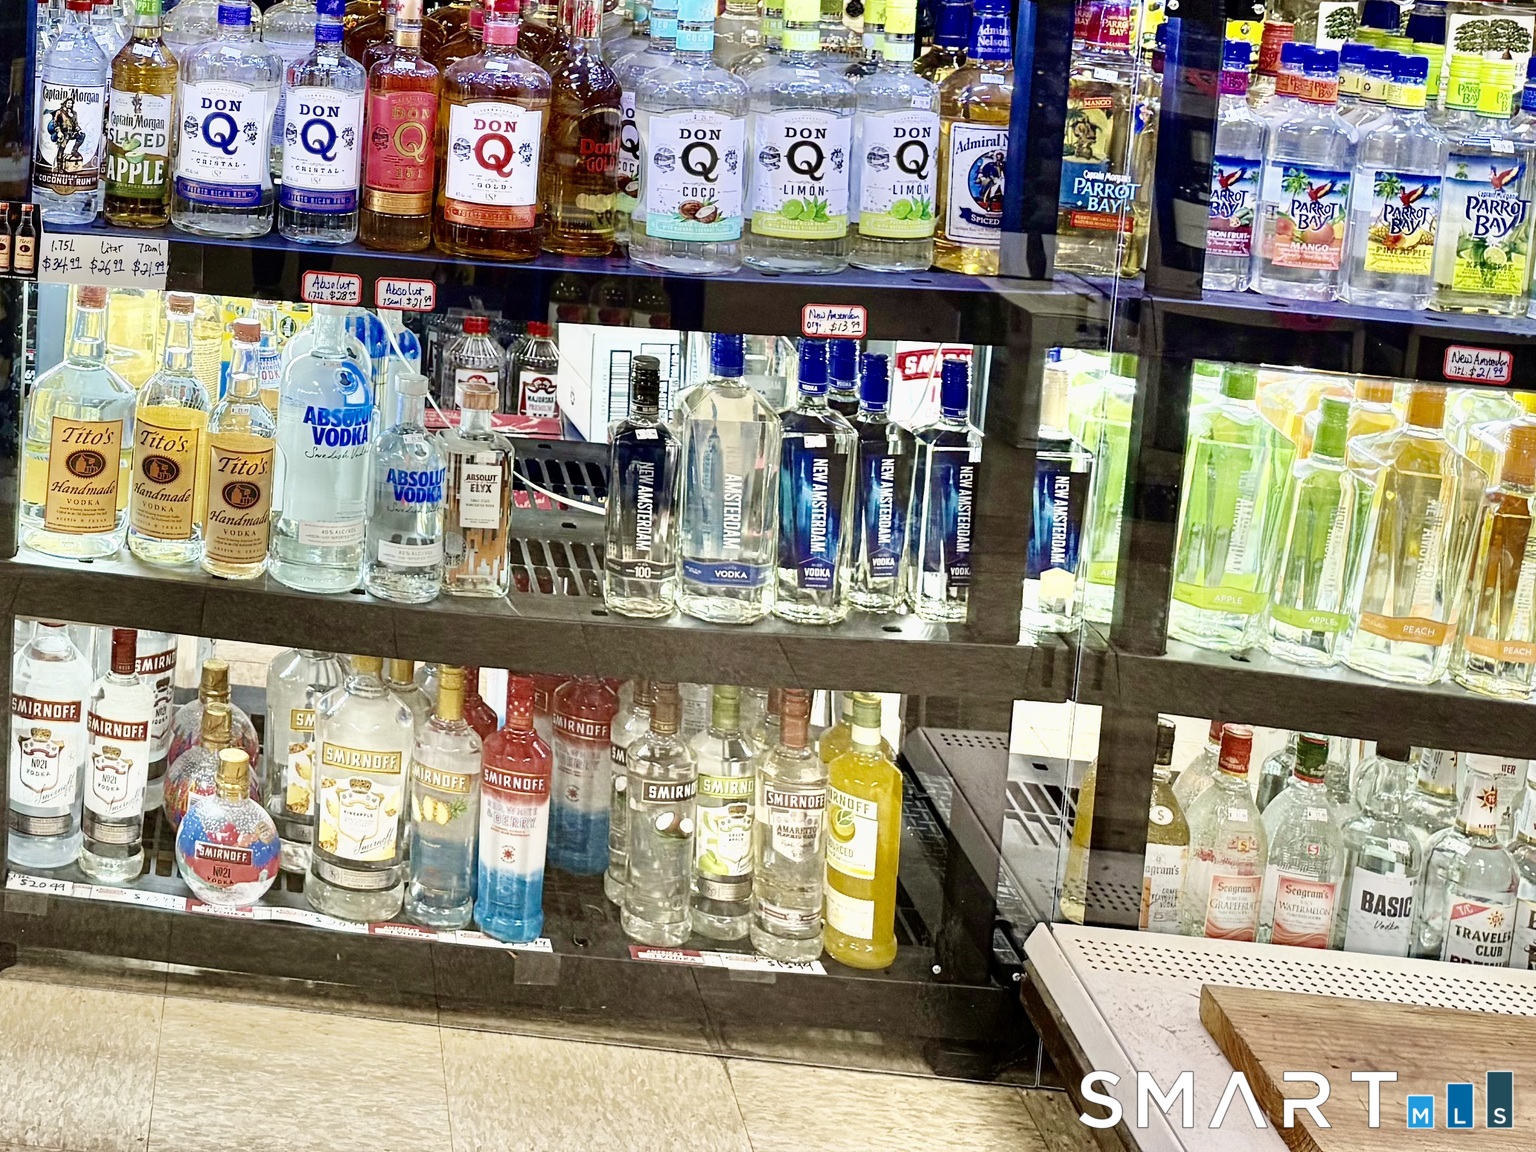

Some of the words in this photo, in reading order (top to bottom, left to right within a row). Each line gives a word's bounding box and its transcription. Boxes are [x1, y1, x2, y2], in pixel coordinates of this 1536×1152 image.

[202, 96, 241, 111] DON
[202, 111, 239, 157] Q
[473, 119, 517, 133] DON
[785, 127, 826, 139] DON
[679, 128, 721, 141] DON
[956, 132, 1000, 154] Admiral
[196, 157, 240, 169] CRISTAL
[476, 132, 520, 179] Q
[679, 141, 720, 181] Q
[785, 139, 825, 180] Q
[38, 175, 74, 186] COCONUT
[107, 160, 164, 186] APPLE
[477, 179, 509, 190] GOLD
[682, 186, 715, 198] COCO
[783, 182, 825, 197] LIMÓN
[1074, 180, 1140, 200] PARROT
[1088, 197, 1120, 212] BAY
[1291, 201, 1337, 220] PARROT
[1466, 197, 1530, 222] PARROT
[1298, 214, 1329, 230] BAY
[1474, 214, 1516, 237] BAY
[1290, 243, 1328, 252] MANGO
[302, 404, 374, 426] ABSOLUT
[62, 428, 113, 444] Tito's
[312, 425, 368, 446] VODKA
[219, 457, 268, 475] Tito's
[813, 458, 827, 481] NEW
[387, 468, 445, 485] ABSOLUT
[52, 478, 116, 495] Handmade
[393, 485, 441, 502] VODKA
[470, 483, 491, 493] ELYX
[1055, 476, 1069, 501] NEW
[210, 508, 268, 527] Handmade
[724, 473, 742, 549] AMSTERDAM
[813, 484, 827, 553] AMSTERDAM
[223, 528, 256, 536] VODKA
[1052, 502, 1067, 563] AMSTERDAM
[715, 569, 747, 579] VODKA
[804, 567, 830, 577] VODKA
[777, 824, 817, 833] AMARETTO
[1218, 881, 1256, 896] Seagram's
[1285, 885, 1328, 899] Seagram's
[1279, 902, 1330, 915] WATERMELON
[1361, 890, 1412, 918] BASIC
[1374, 920, 1399, 932] Vodka
[1476, 944, 1502, 957] CLUB
